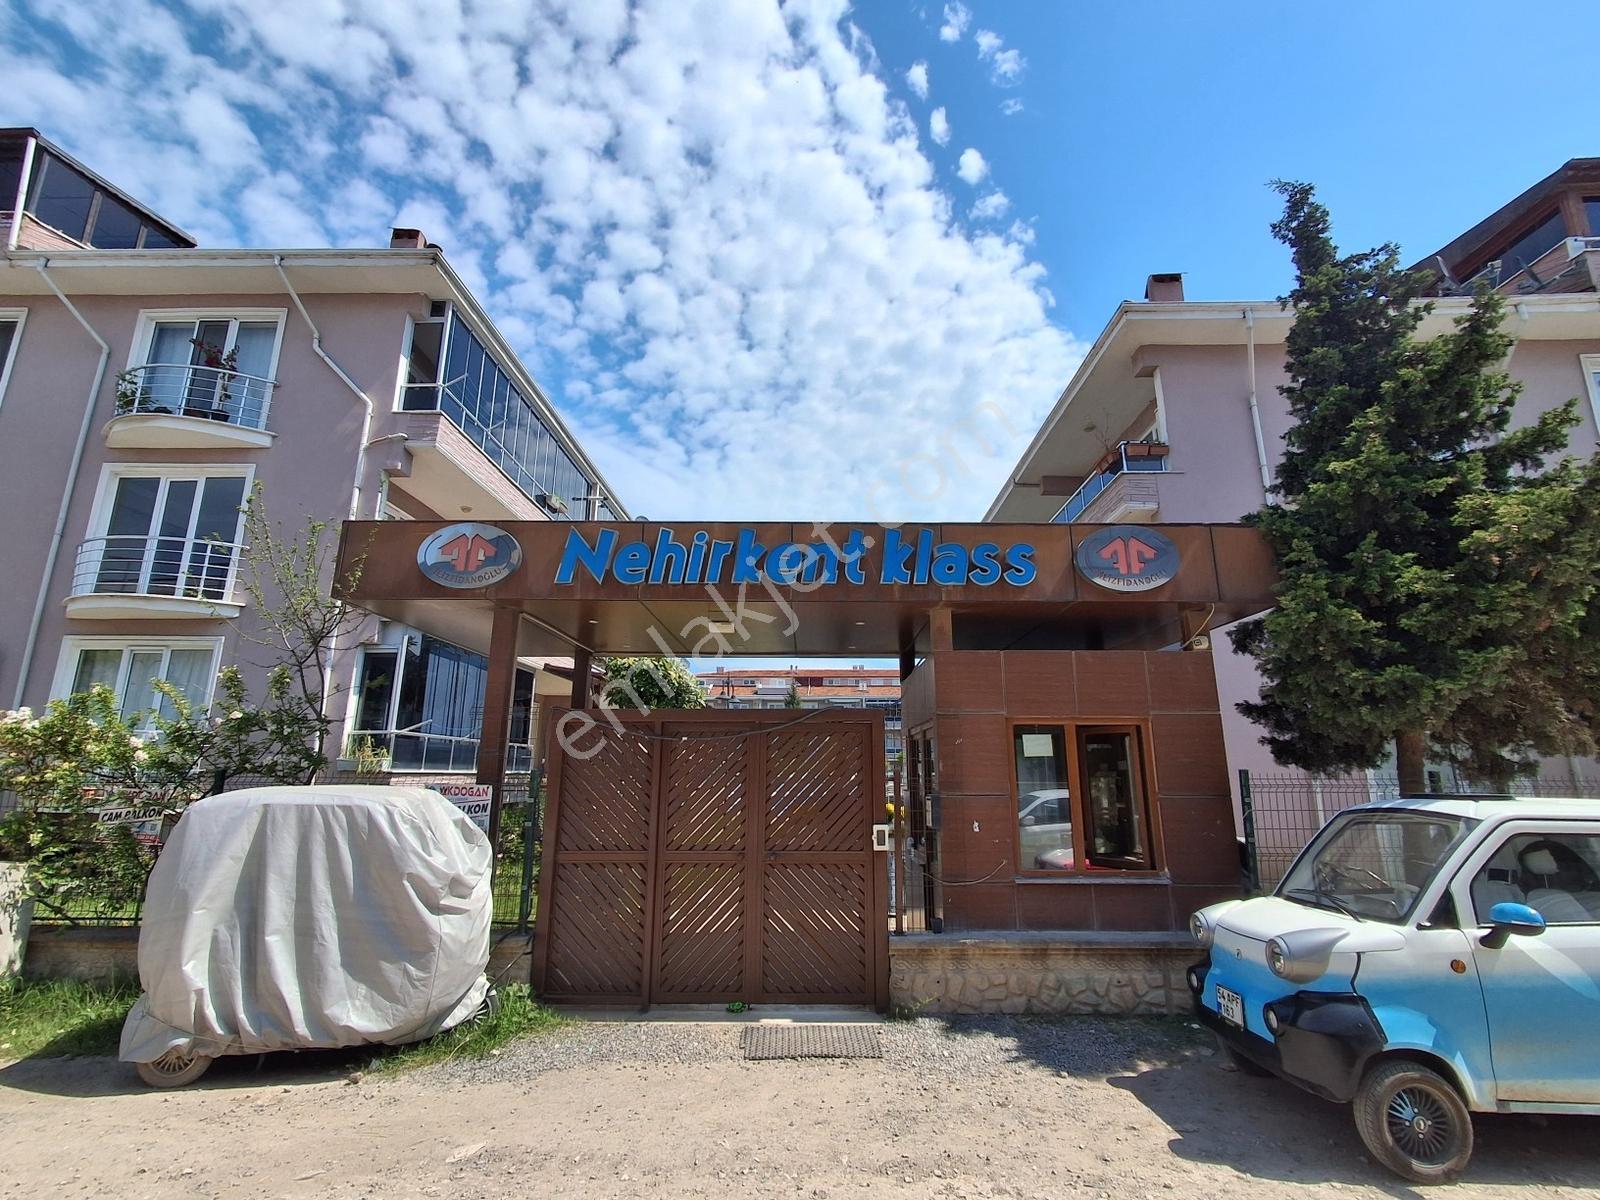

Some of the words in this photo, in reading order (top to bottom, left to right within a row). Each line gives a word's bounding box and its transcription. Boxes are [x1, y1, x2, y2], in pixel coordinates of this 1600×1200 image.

[554, 526, 866, 585] Nehirkent
[880, 528, 1037, 586] klass
[101, 811, 123, 822] CAM
